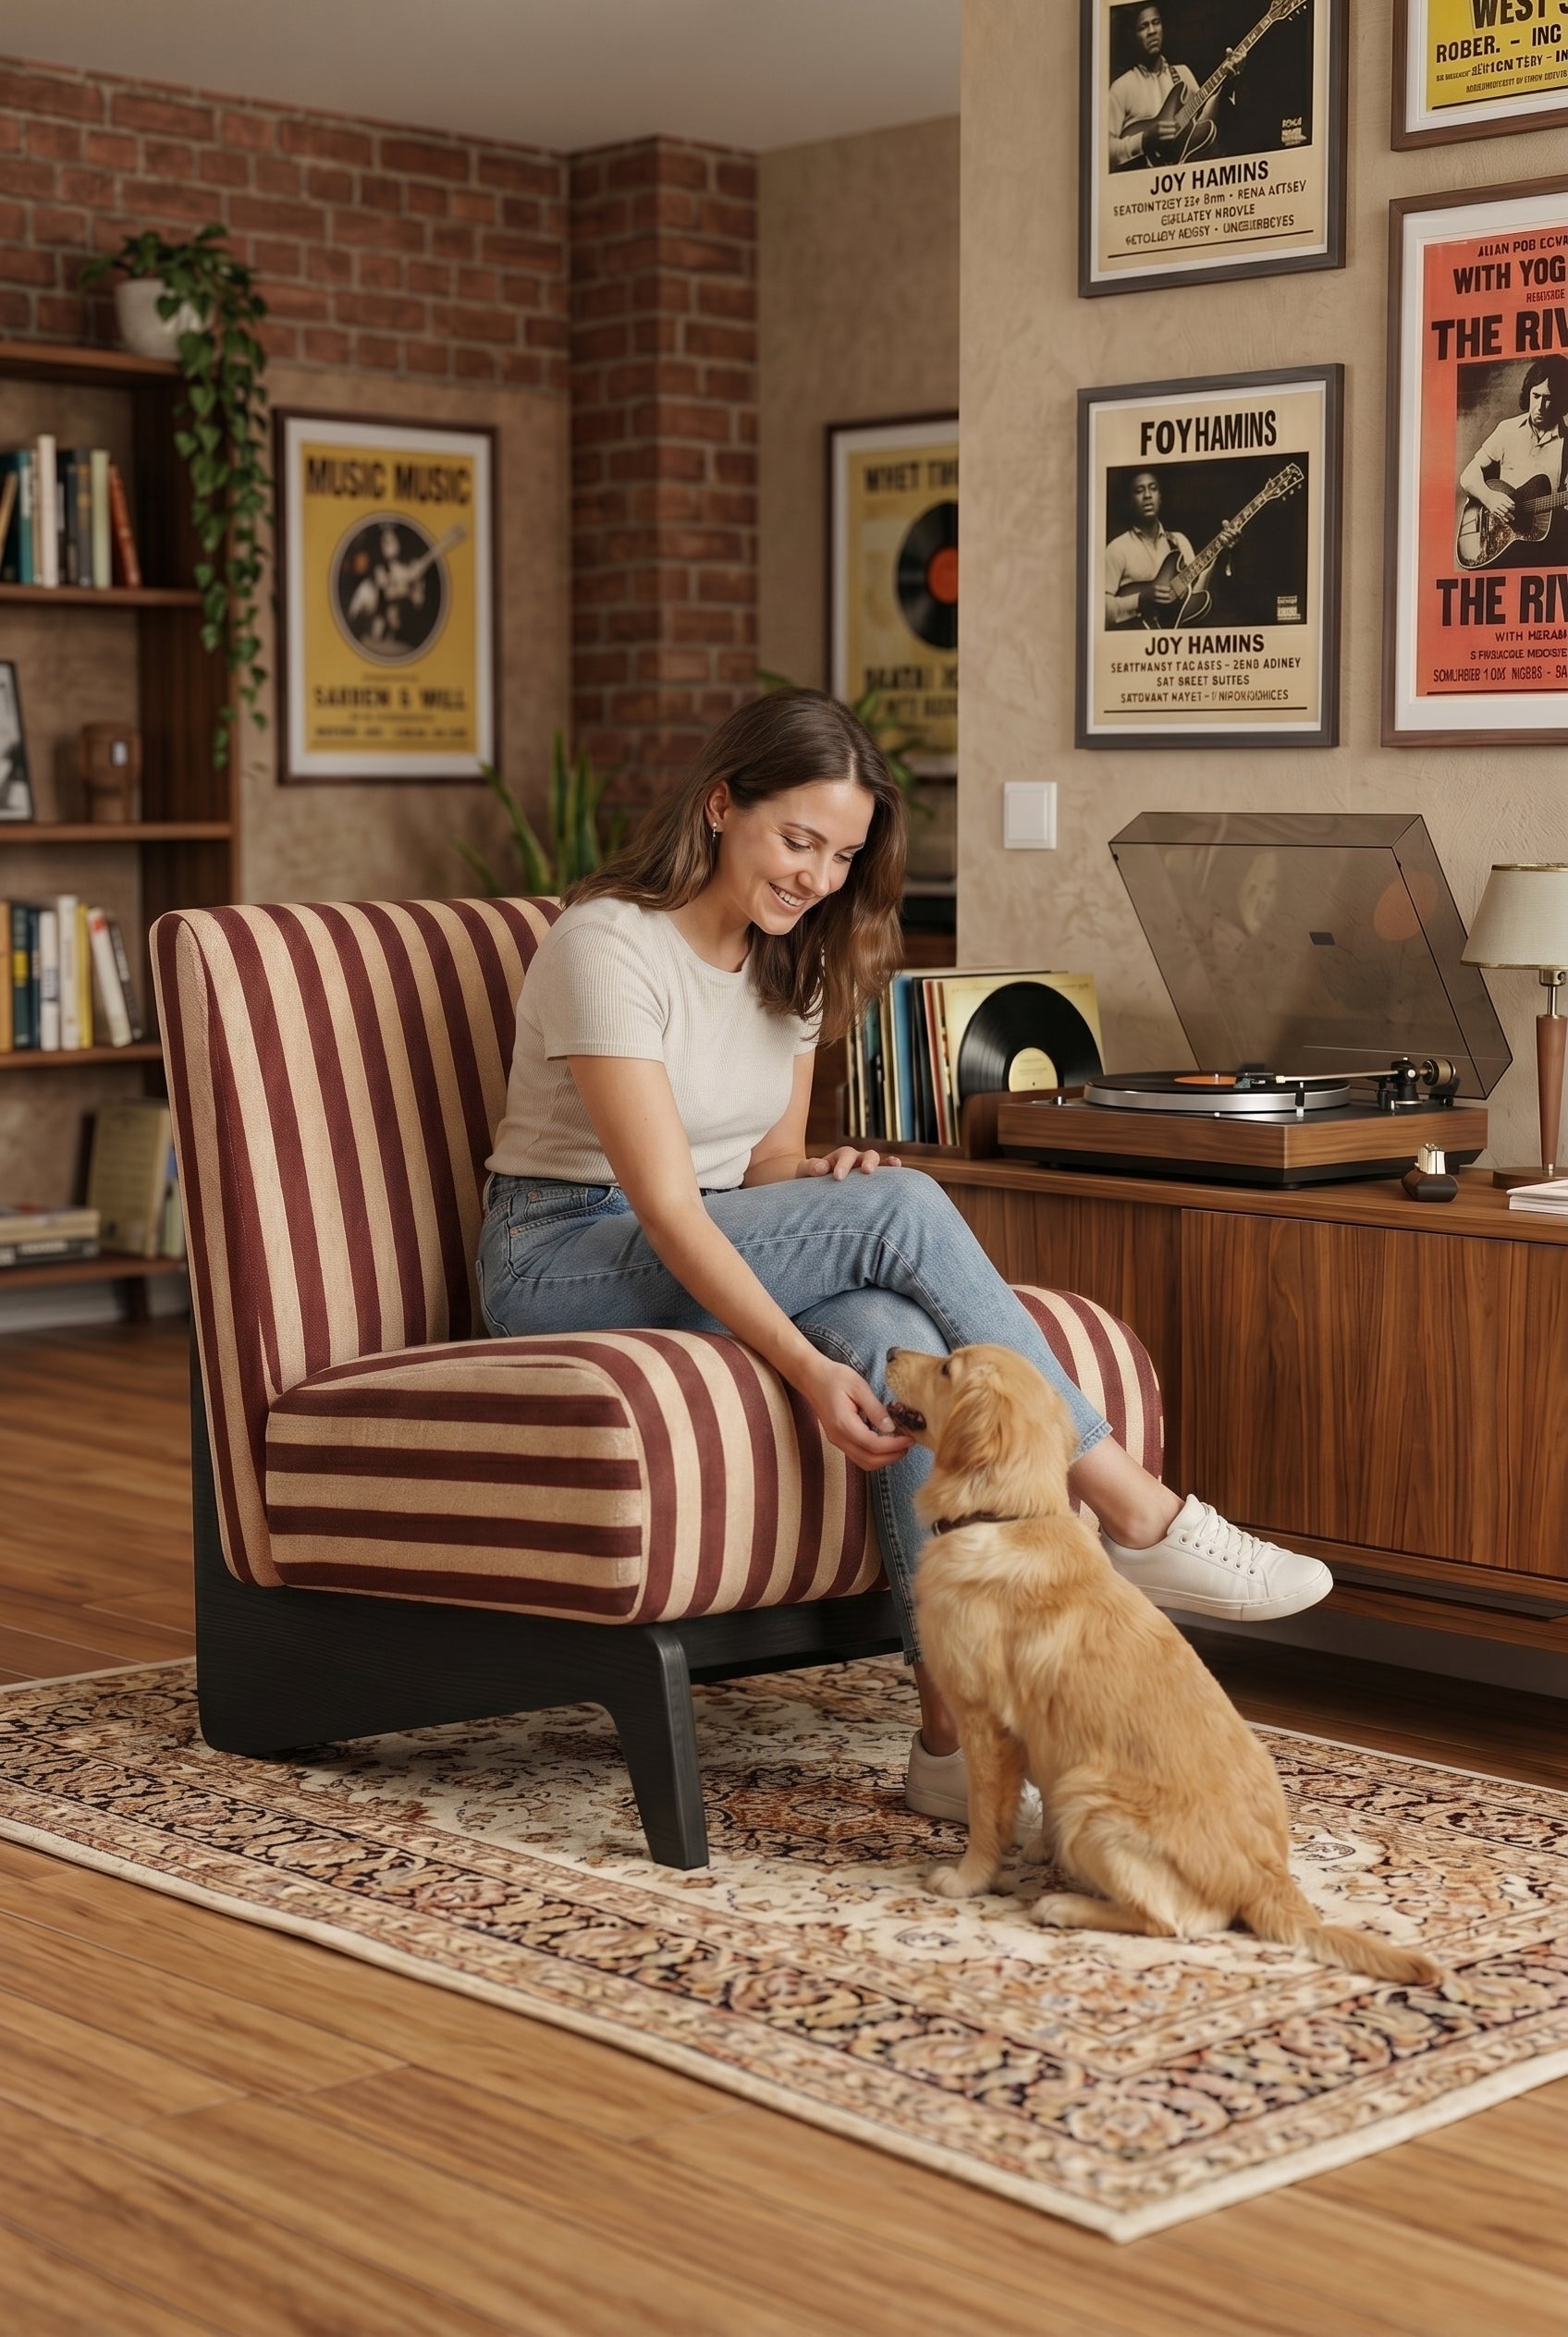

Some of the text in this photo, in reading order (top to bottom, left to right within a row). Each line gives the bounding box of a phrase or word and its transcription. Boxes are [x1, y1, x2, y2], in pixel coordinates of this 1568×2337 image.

[1436, 35, 1501, 64] ROBER.
[1531, 23, 1562, 47] INC
[1150, 160, 1269, 195] JOY HAMINS
[1238, 186, 1266, 200] RENA
[1453, 255, 1566, 295] WITH YOG
[1431, 314, 1502, 361] THE
[308, 457, 471, 505] MUSIC MUSIC
[1436, 576, 1506, 626] THE
[1145, 634, 1265, 656] JOY HAMINS
[1495, 631, 1524, 642] WITH
[1263, 657, 1301, 668] ADINEY
[1157, 676, 1174, 687] SAT
